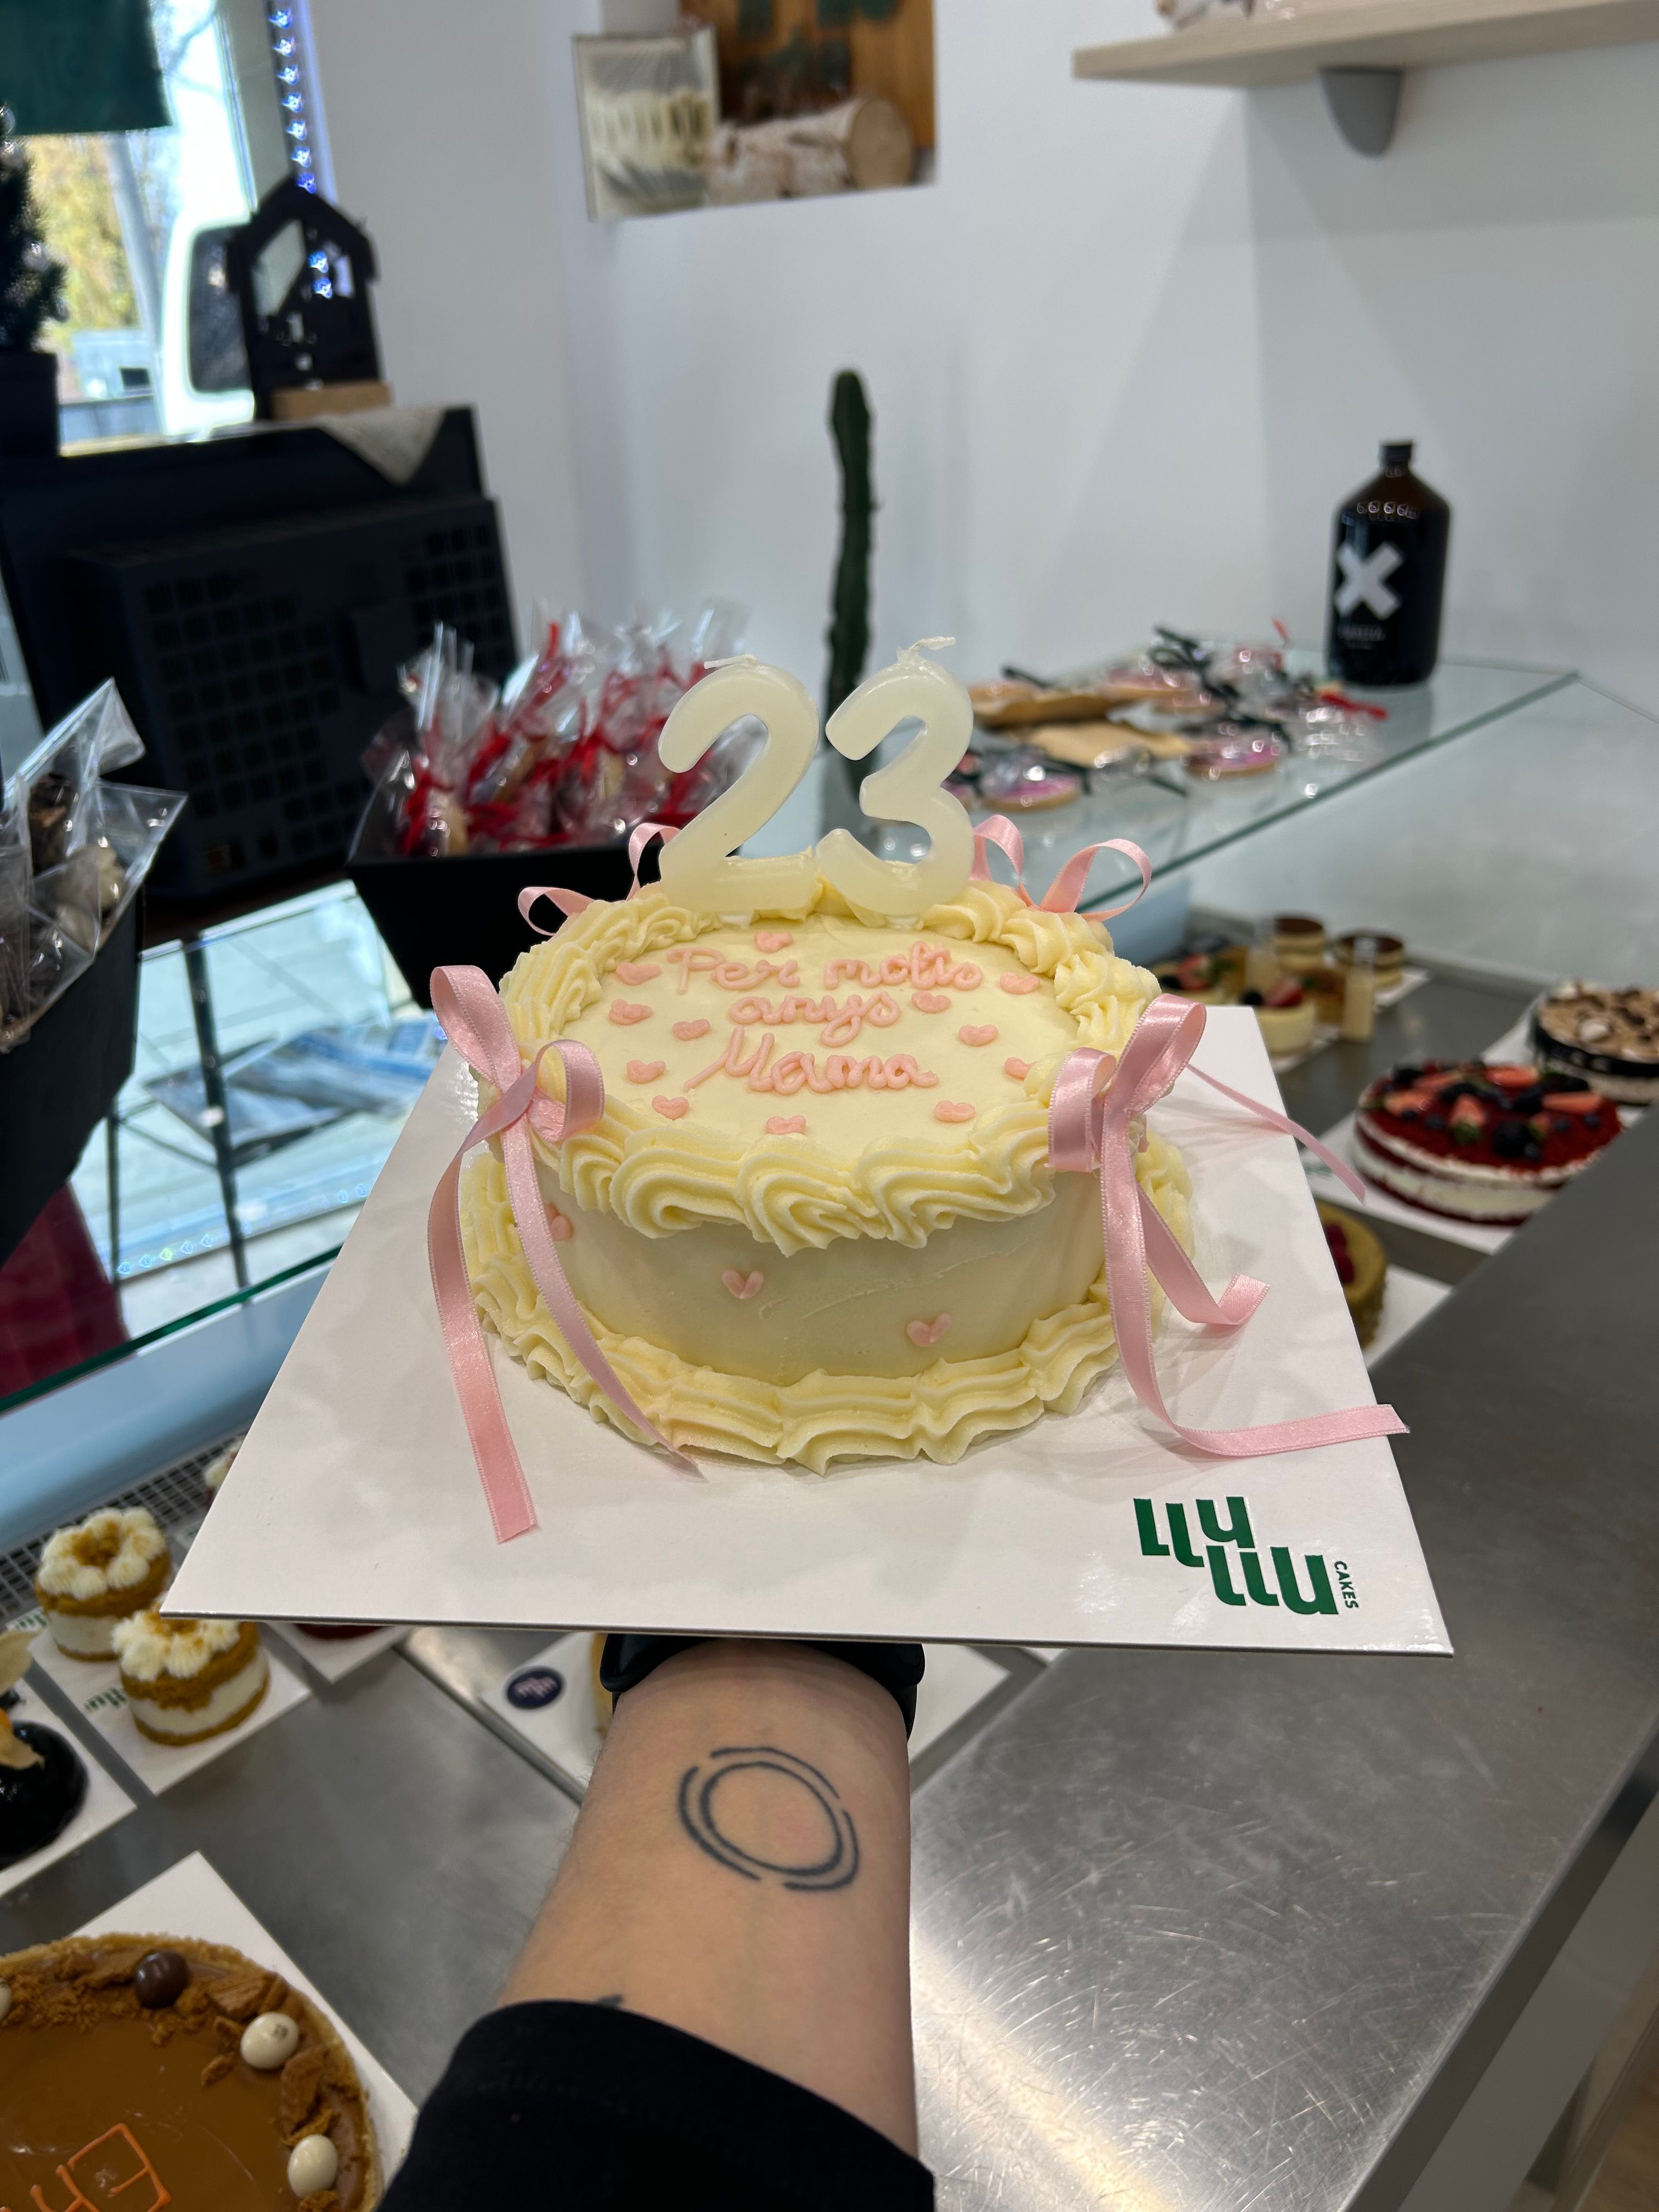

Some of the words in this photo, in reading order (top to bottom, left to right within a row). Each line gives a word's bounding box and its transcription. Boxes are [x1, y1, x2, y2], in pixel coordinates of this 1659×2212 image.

[659, 656, 974, 915] 23
[667, 947, 801, 995] Per
[824, 940, 984, 991] molts
[729, 990, 901, 1047] anys
[683, 1025, 940, 1095] Mama
[1334, 1560, 1359, 1609] CAKES
